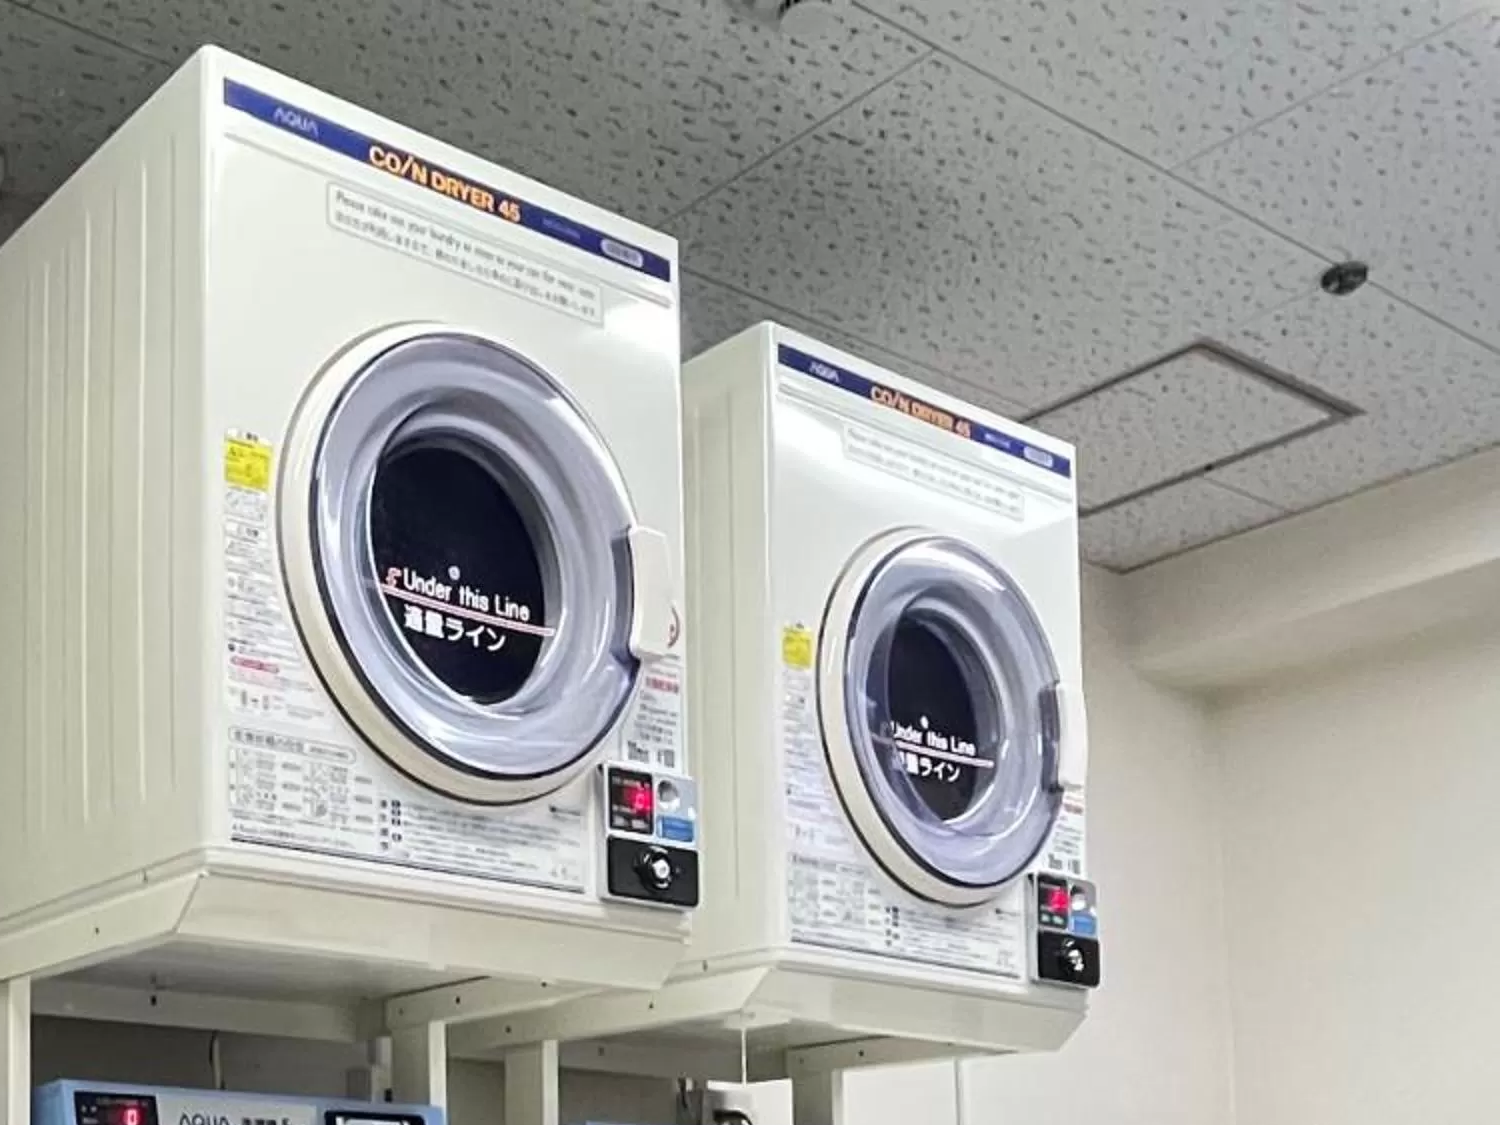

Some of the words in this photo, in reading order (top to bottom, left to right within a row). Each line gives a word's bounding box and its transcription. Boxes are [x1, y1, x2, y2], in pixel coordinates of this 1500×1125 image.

[430, 169, 495, 214] DRYER
[498, 198, 521, 224] 45
[403, 567, 452, 602] Under
[459, 585, 489, 613] this
[494, 594, 530, 622] Line
[403, 603, 506, 652] 適量ライン
